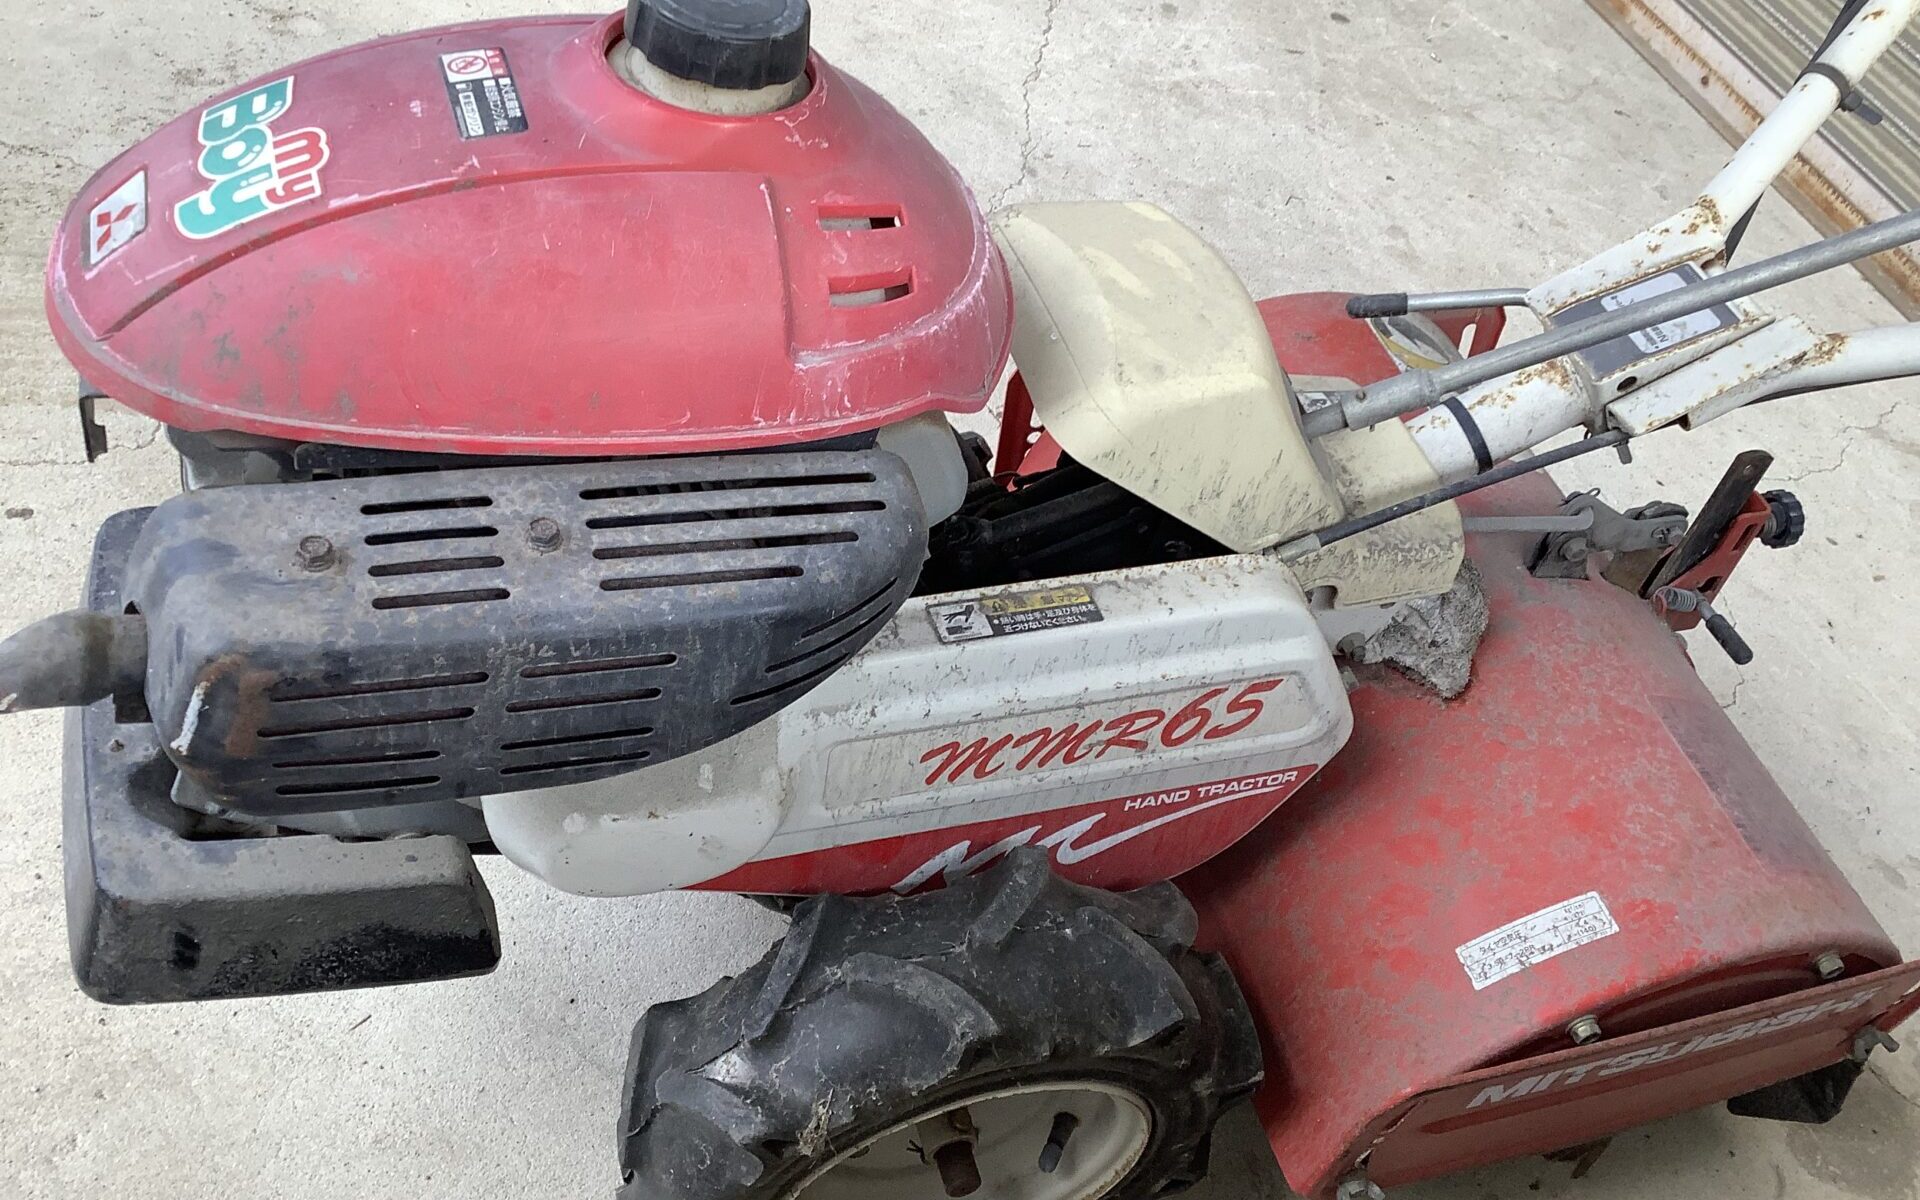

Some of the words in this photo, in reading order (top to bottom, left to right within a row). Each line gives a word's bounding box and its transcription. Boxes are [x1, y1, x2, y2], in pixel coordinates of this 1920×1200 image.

[919, 678, 1285, 786] MMR65
[1123, 788, 1192, 812] HAND
[1197, 770, 1299, 797] TRACTOR
